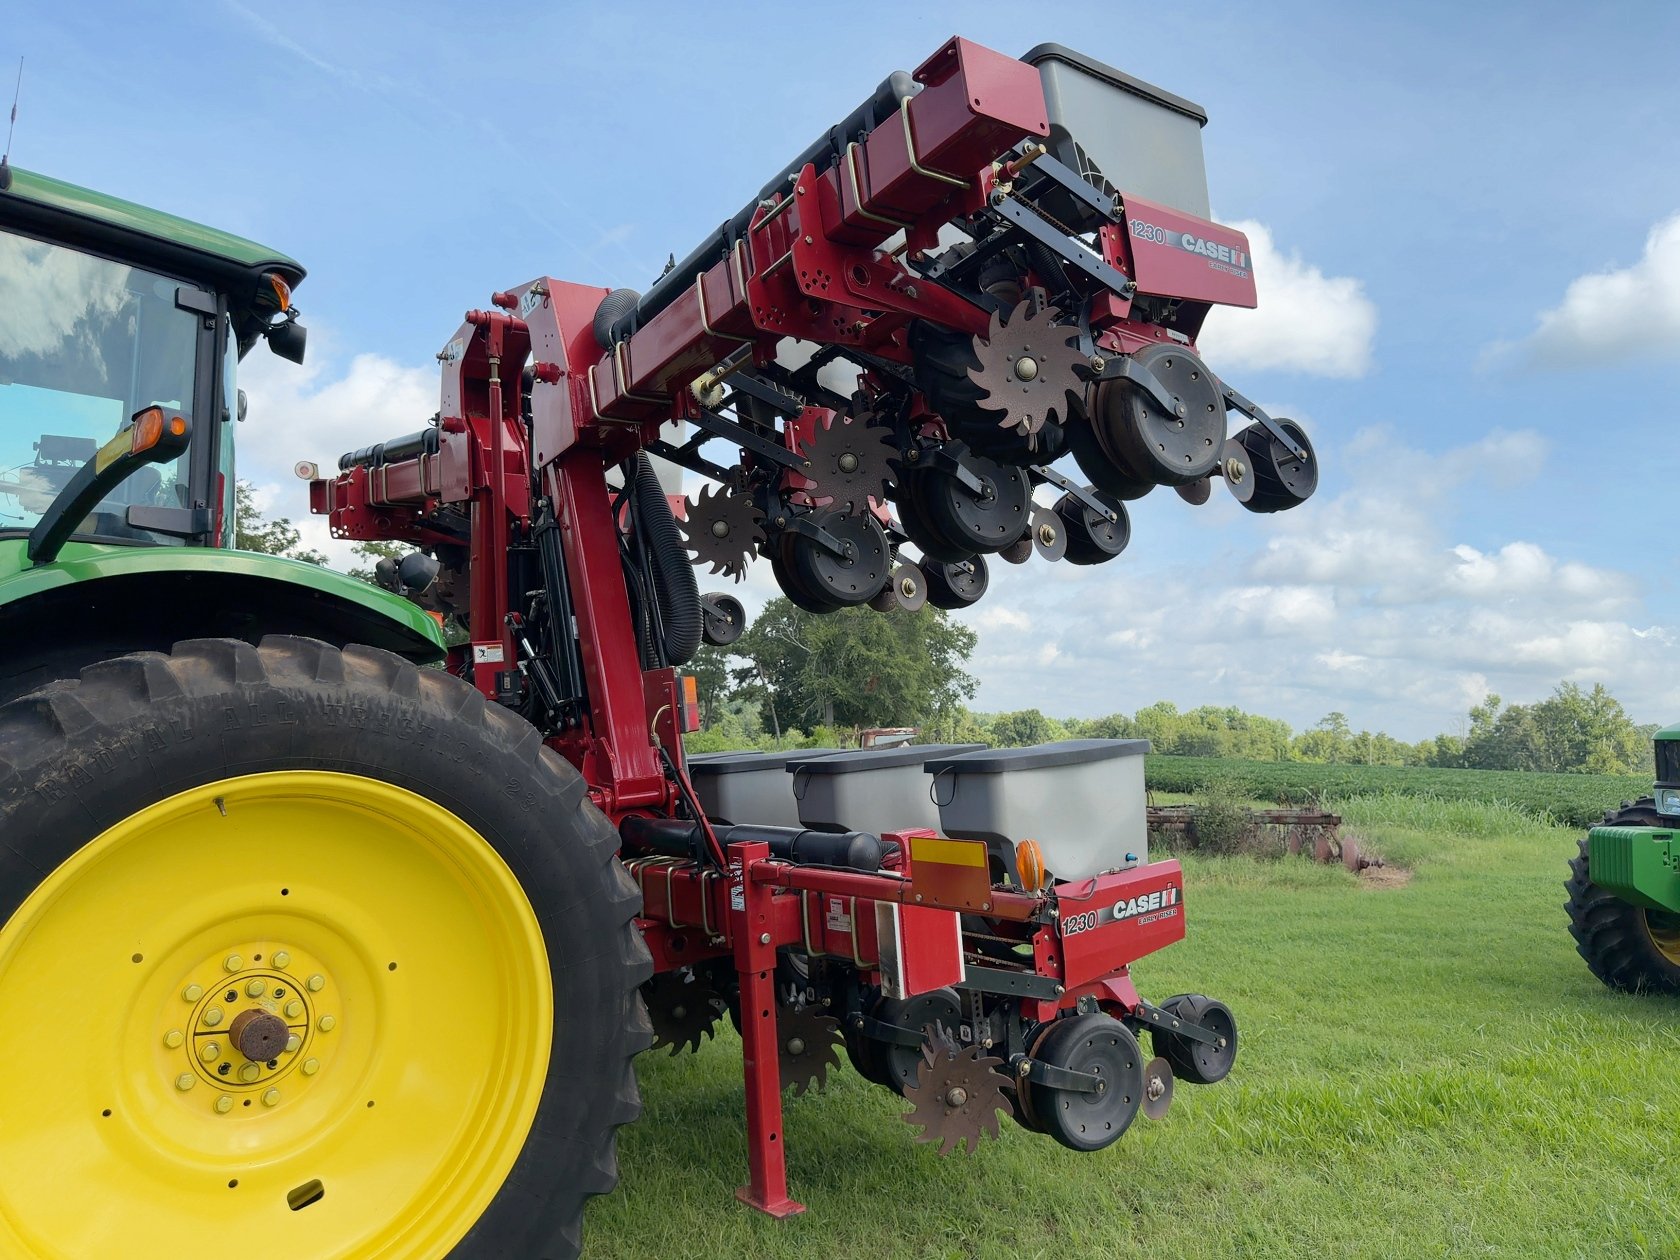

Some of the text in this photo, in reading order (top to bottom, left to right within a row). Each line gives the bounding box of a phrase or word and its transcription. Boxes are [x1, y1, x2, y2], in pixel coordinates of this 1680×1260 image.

[1129, 219, 1165, 245] 1230
[1181, 233, 1229, 262] CASE
[34, 719, 193, 805] RADIAL
[223, 700, 298, 732] ALL
[1062, 910, 1097, 937] 1230
[1113, 892, 1160, 919] CASE
[1138, 909, 1177, 925] EARLY RISER
